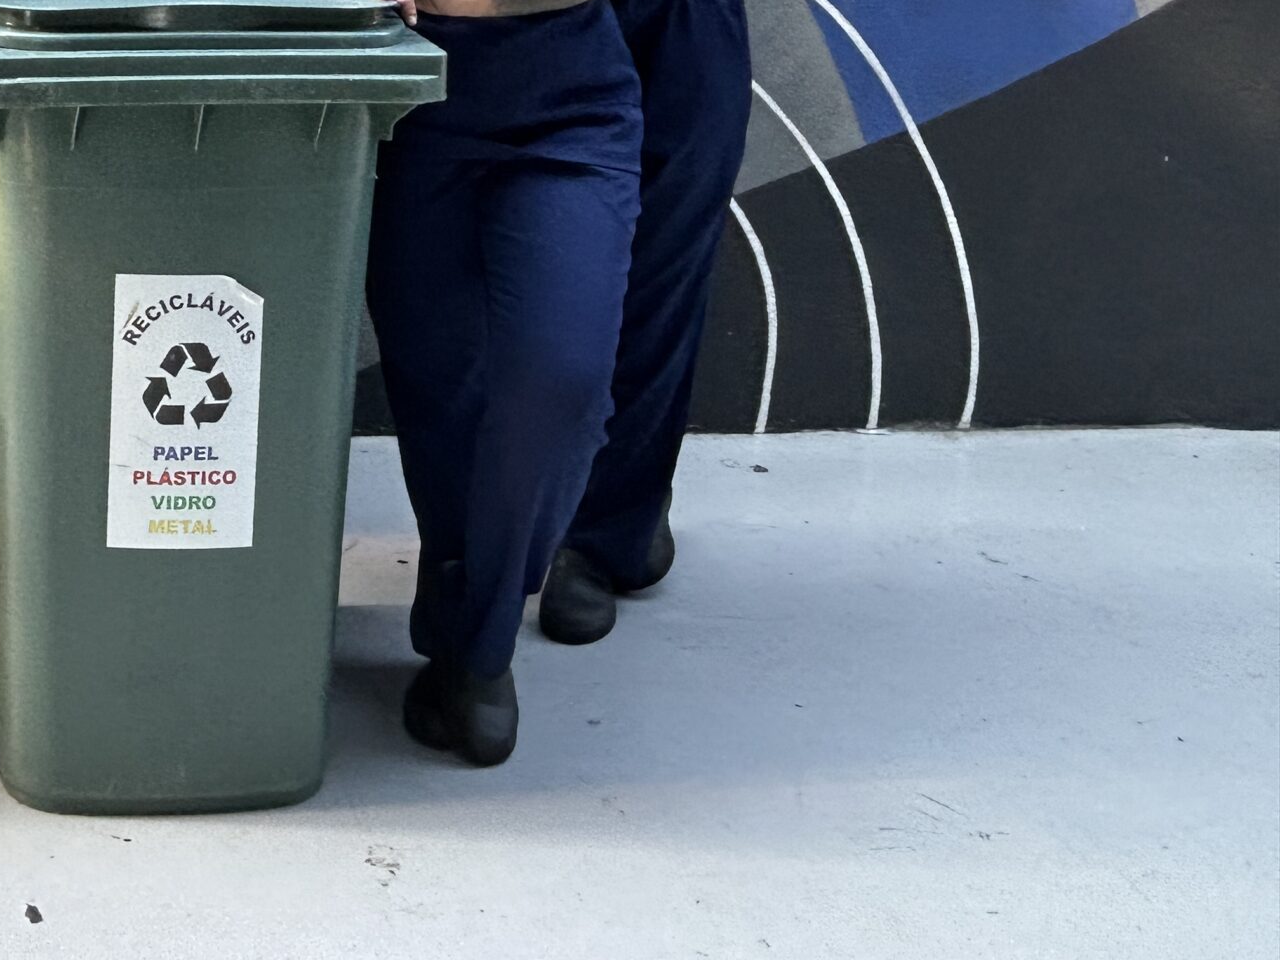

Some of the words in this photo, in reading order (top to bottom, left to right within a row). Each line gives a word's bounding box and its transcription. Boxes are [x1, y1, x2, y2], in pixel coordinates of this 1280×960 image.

[122, 292, 256, 346] RECICLÁVEIS
[153, 445, 219, 461] PAPEL
[132, 467, 237, 485] PLÁSTICO
[151, 495, 217, 510] VIDRO
[147, 519, 218, 535] METAL
